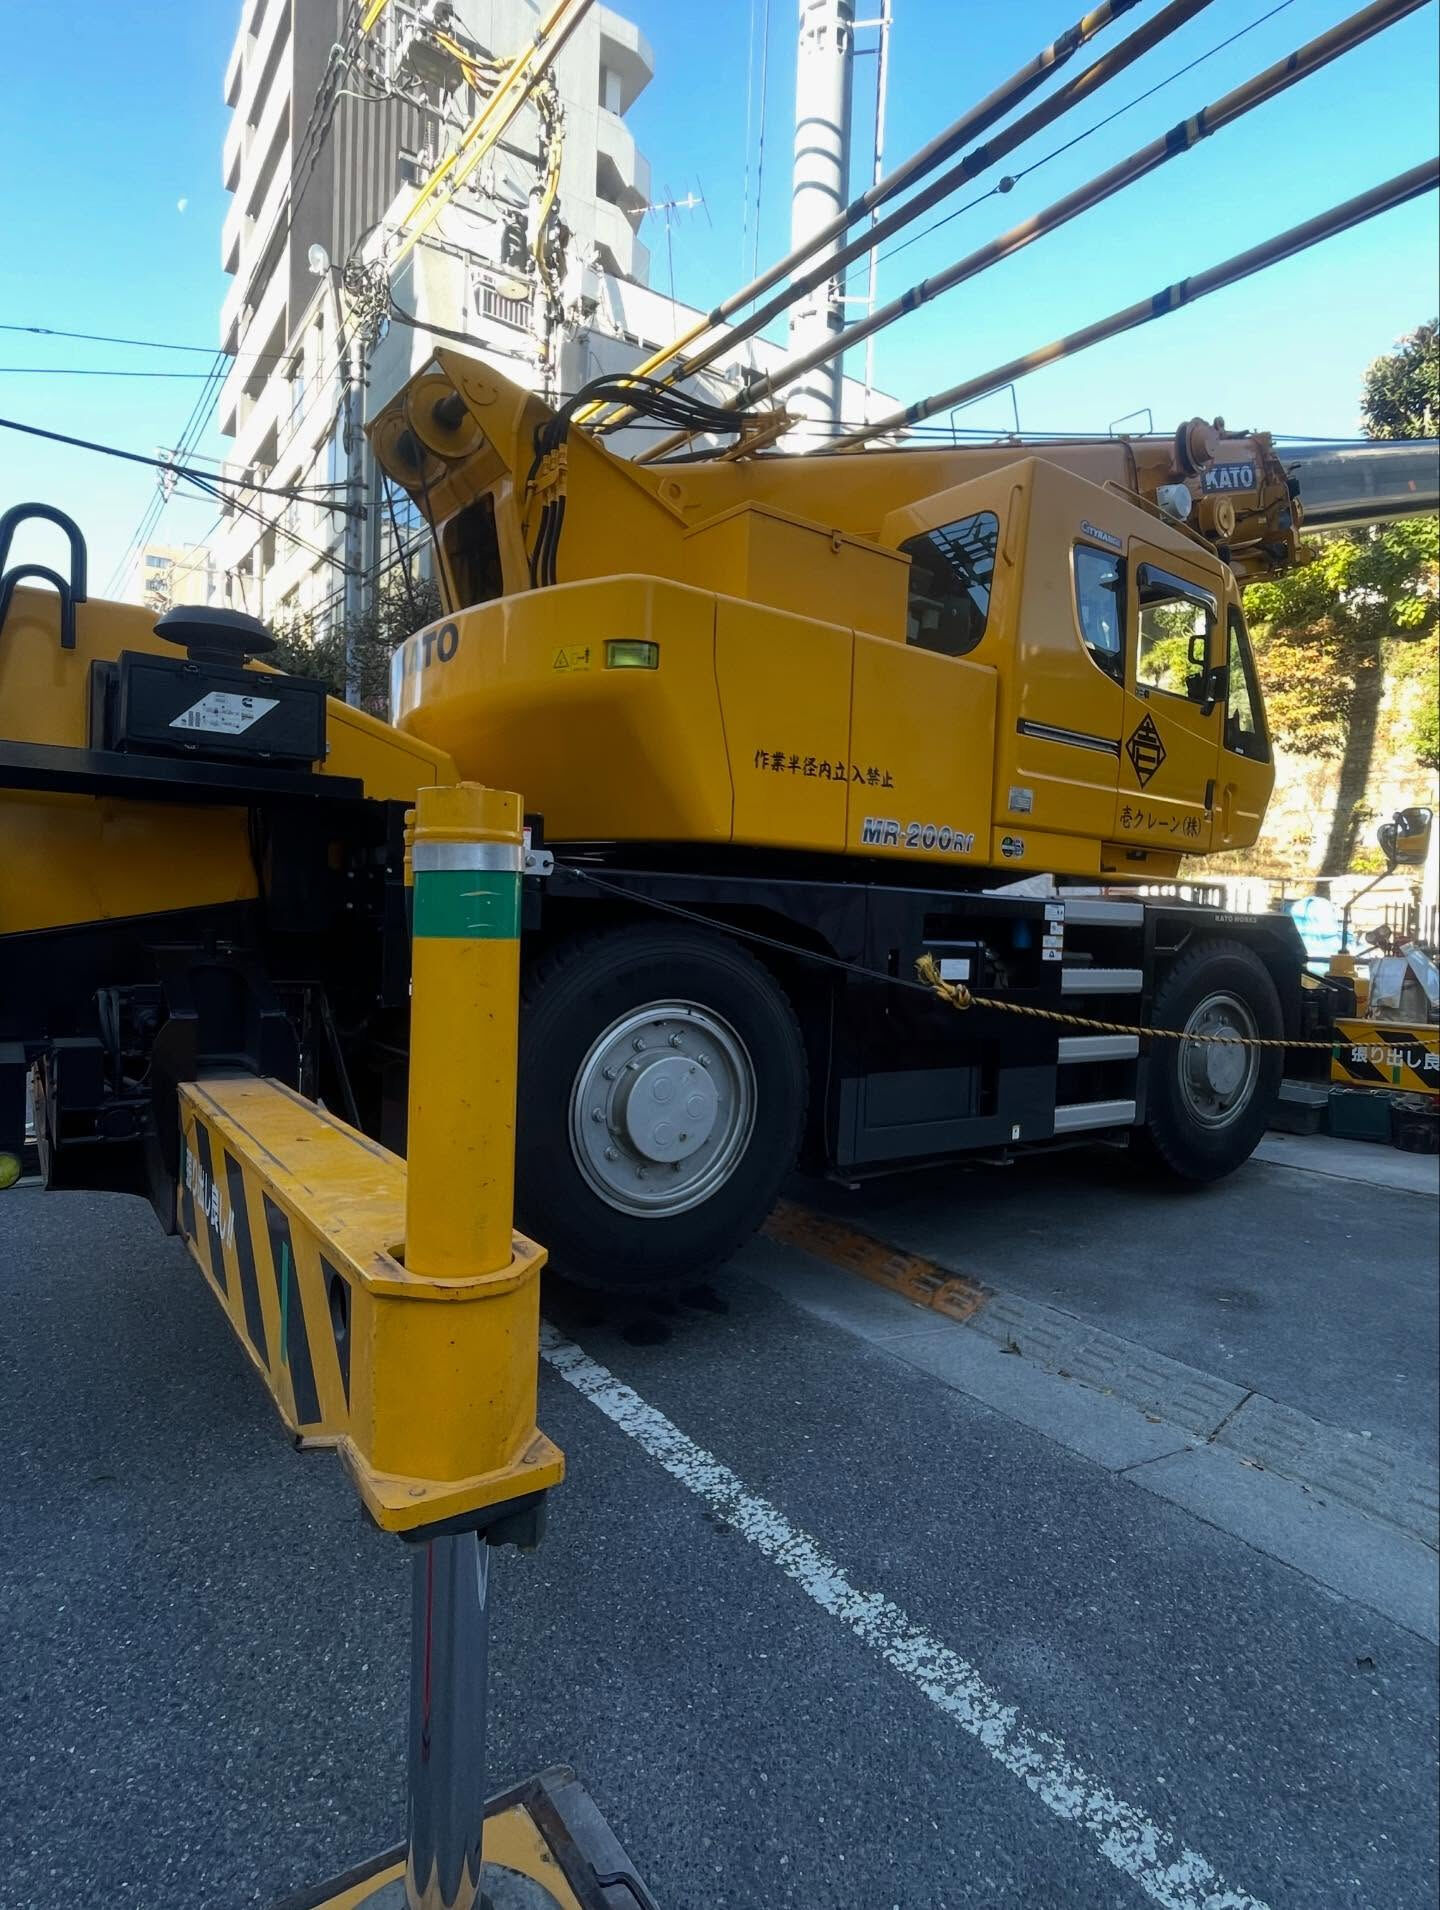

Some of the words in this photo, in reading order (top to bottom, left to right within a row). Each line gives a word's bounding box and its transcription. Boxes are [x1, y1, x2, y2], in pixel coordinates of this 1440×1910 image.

[1205, 465, 1253, 490] KATO
[754, 749, 895, 789] 作業半径内立入禁止
